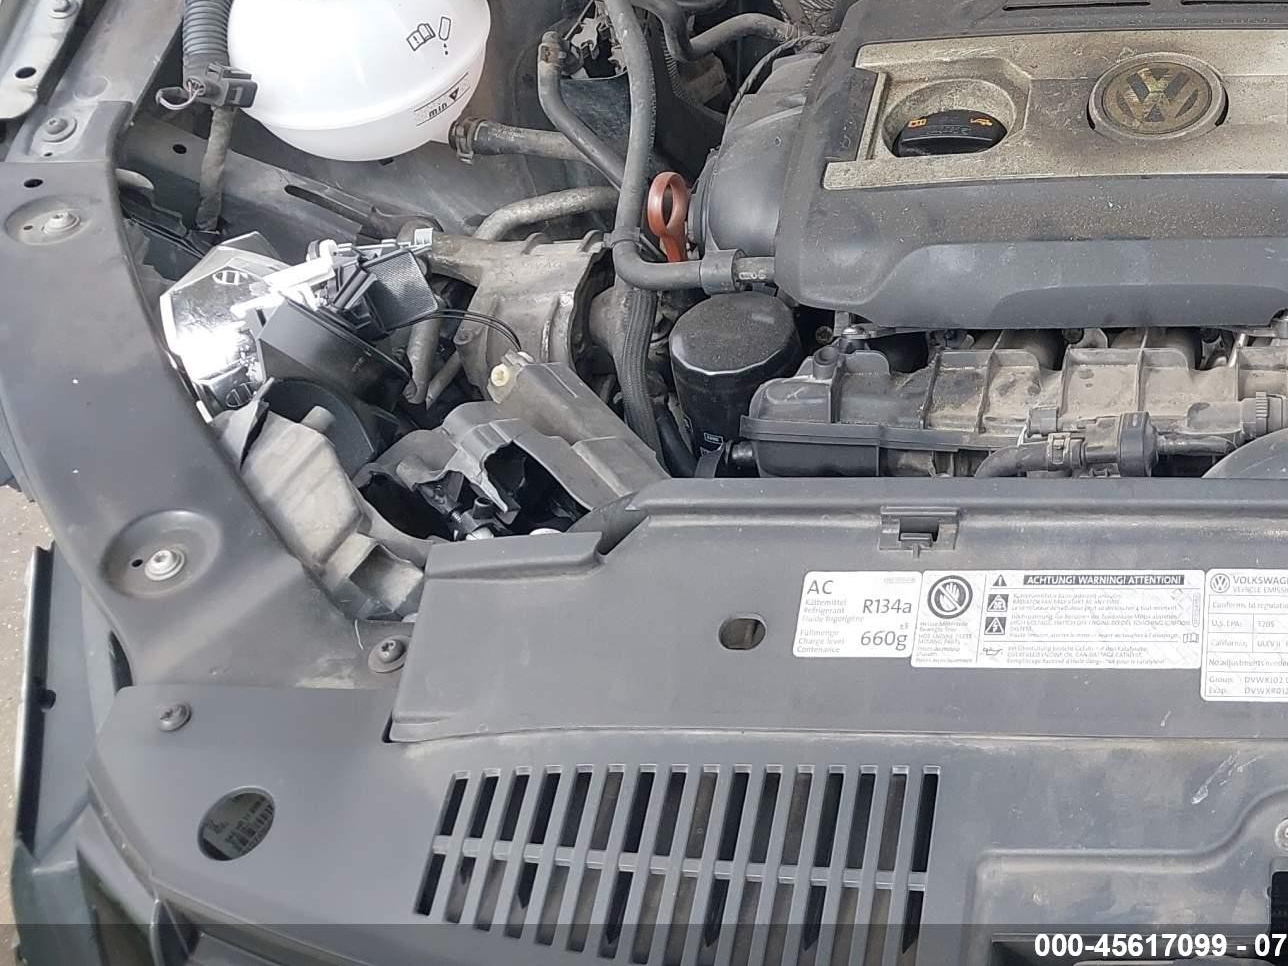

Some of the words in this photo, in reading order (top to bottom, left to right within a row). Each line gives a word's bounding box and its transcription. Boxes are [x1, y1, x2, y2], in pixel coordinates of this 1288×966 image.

[428, 102, 448, 118] min
[862, 598, 912, 614] R134a
[860, 630, 908, 652] 660g
